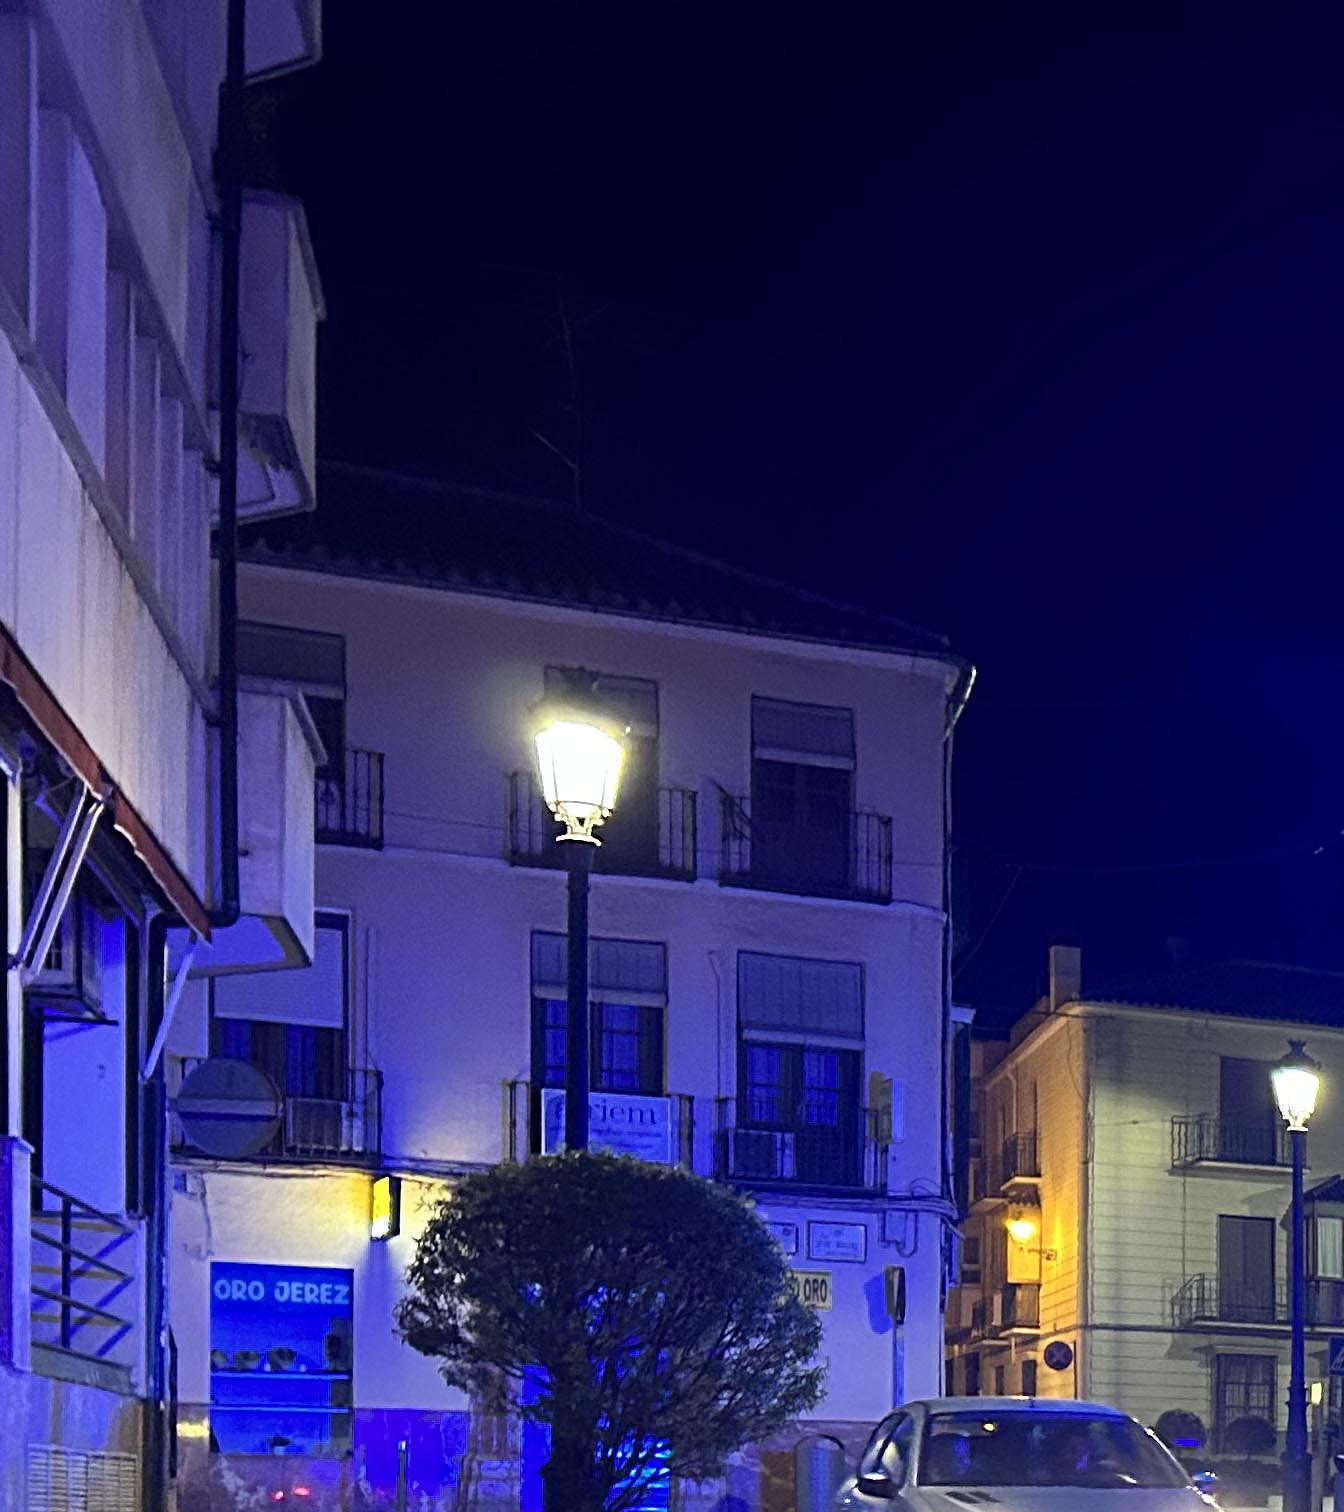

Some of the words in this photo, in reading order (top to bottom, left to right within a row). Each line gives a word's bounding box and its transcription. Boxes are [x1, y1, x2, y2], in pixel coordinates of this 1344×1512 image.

[213, 1279, 265, 1301] ORO
[274, 1281, 350, 1305] JEREZ
[803, 1278, 828, 1303] ORO
